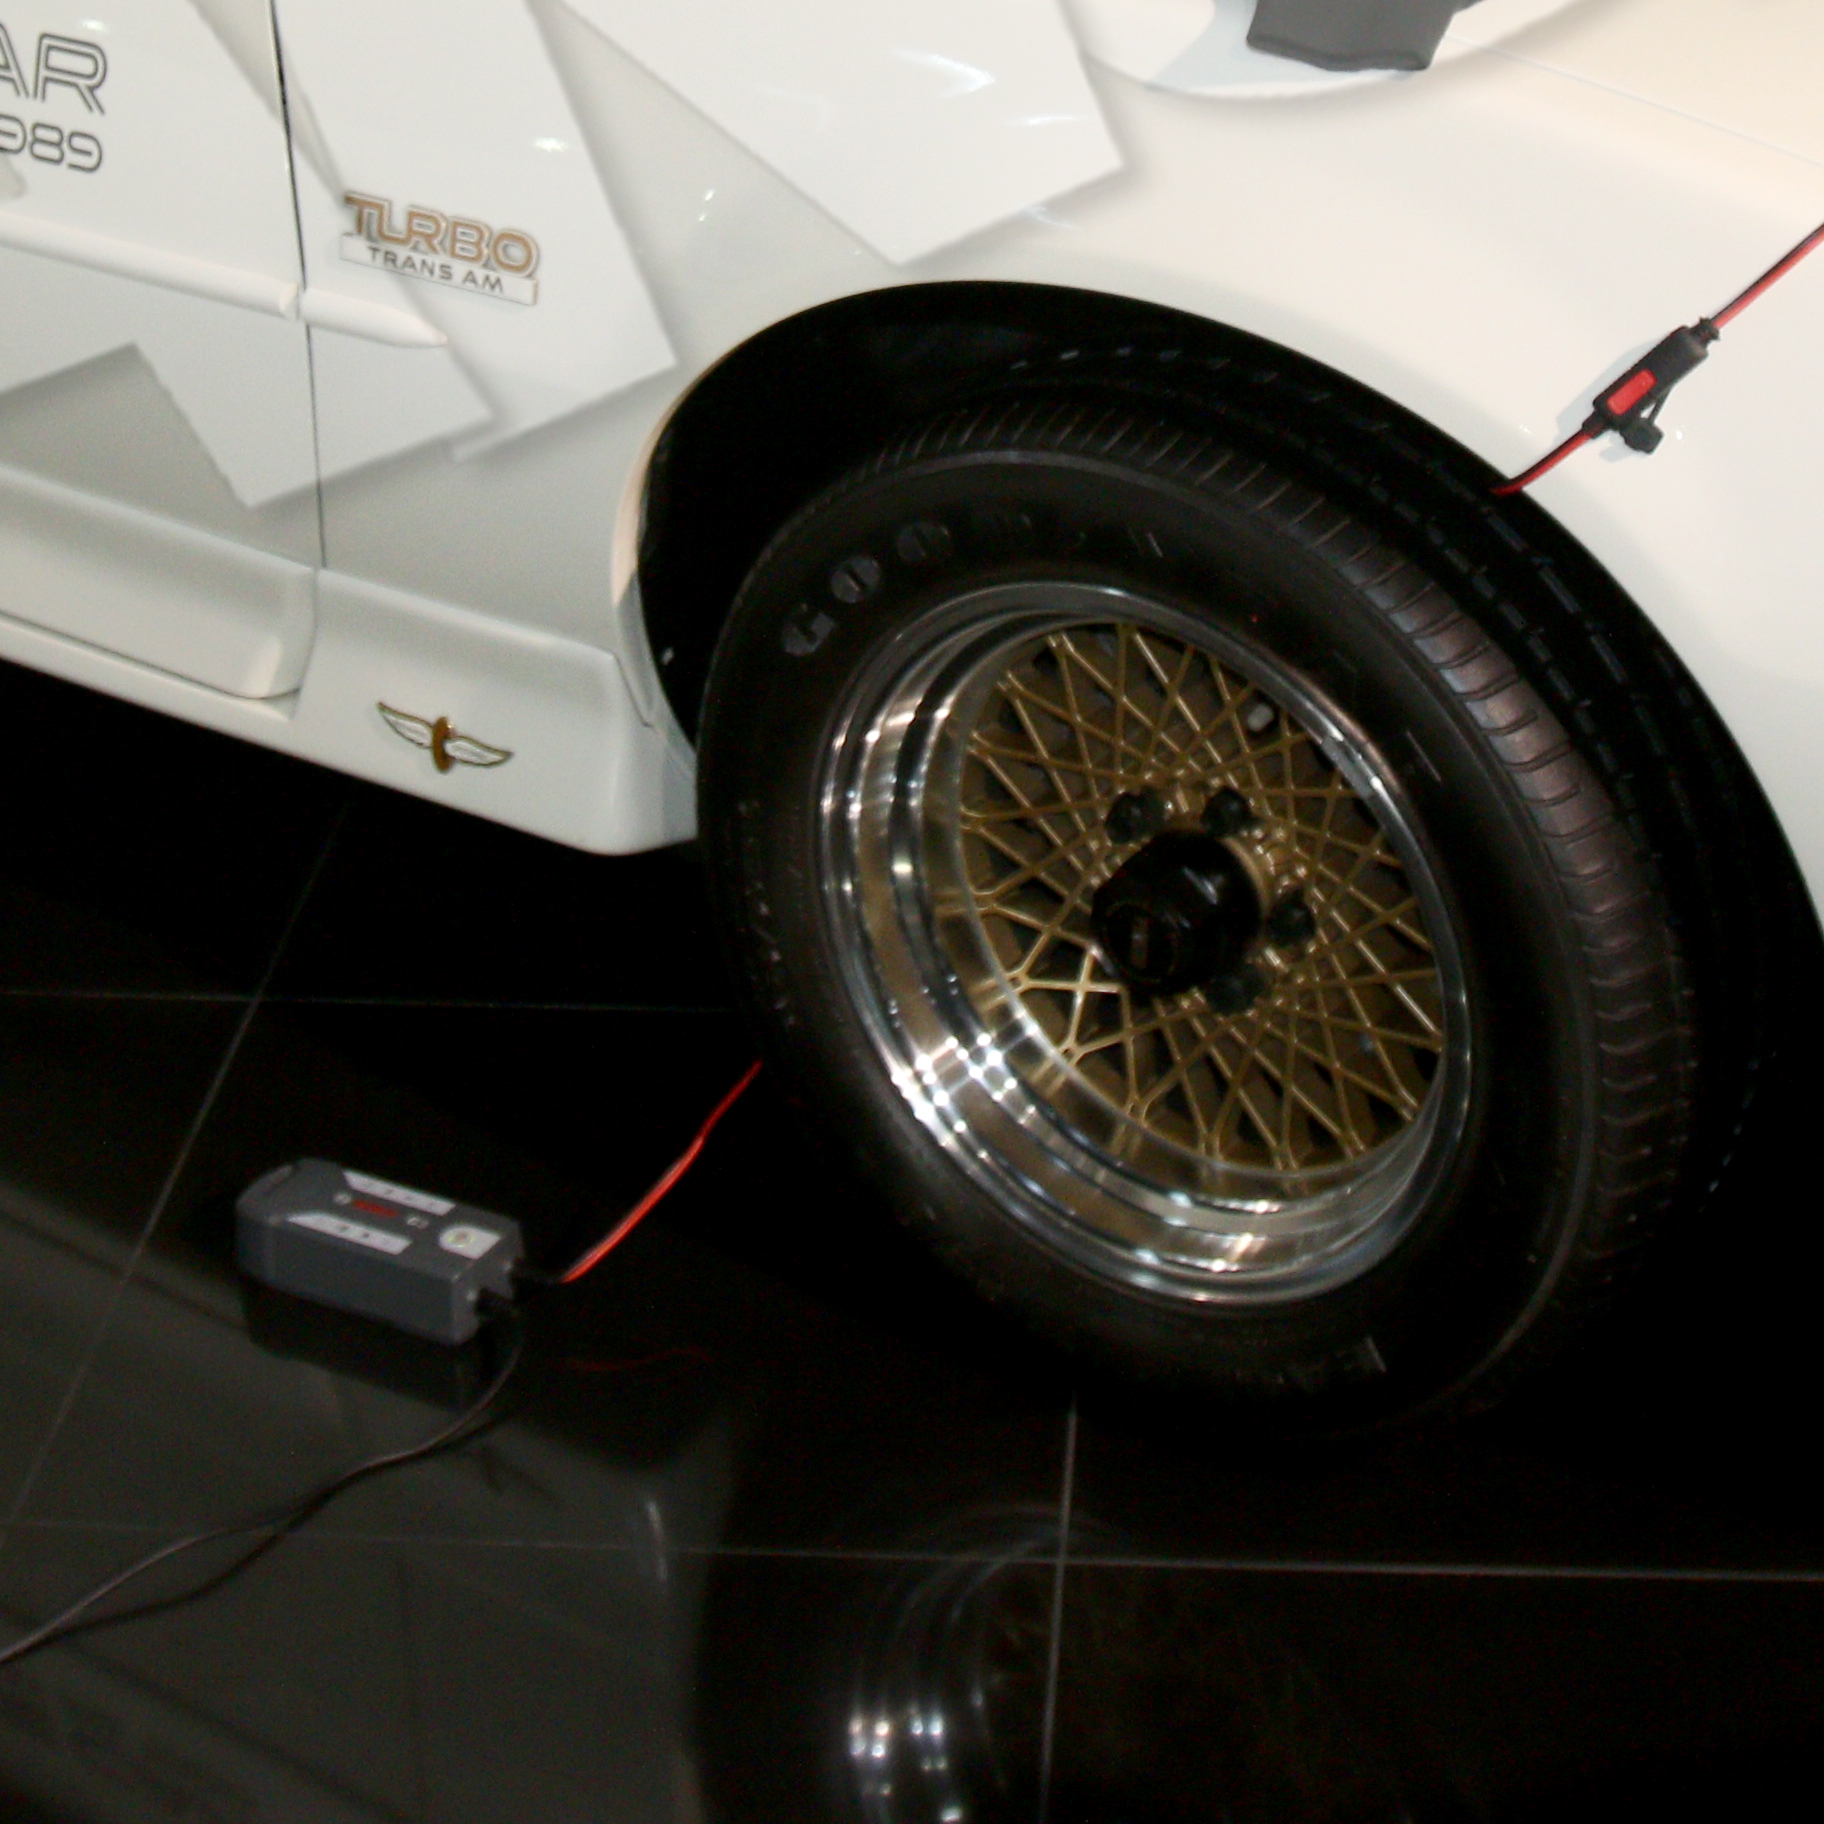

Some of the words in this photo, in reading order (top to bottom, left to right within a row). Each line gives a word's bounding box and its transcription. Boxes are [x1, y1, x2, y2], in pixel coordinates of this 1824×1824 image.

[343, 189, 540, 276] TURBO
[367, 244, 454, 281] TRANS
[462, 269, 505, 295] AM
